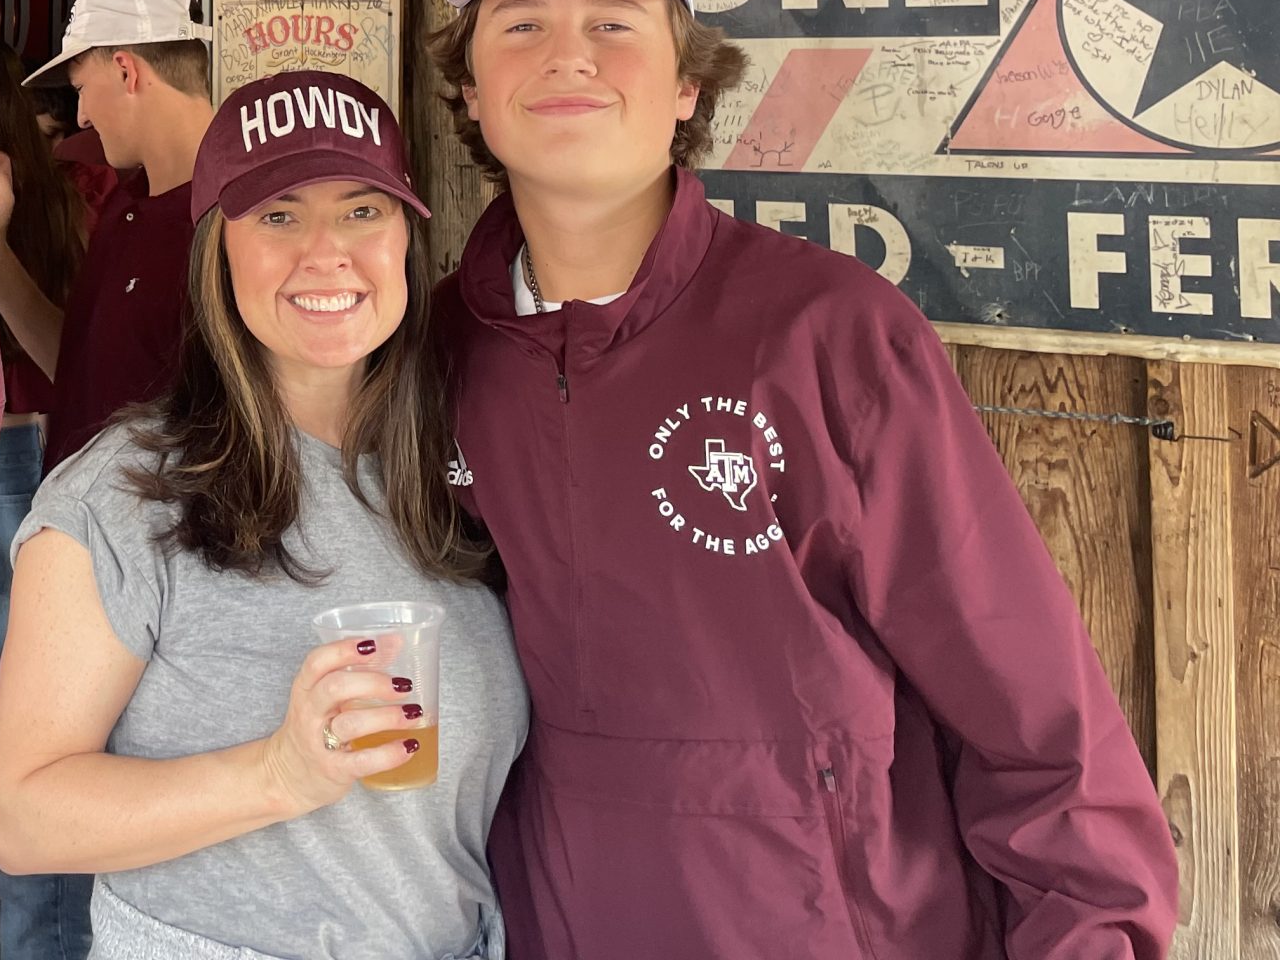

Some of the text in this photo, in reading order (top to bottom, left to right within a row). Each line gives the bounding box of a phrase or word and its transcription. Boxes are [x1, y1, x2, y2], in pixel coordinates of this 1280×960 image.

[244, 14, 360, 57] HOURS
[240, 86, 382, 152] HOWDY
[1195, 78, 1255, 102] DYLAN
[649, 396, 785, 472] ONLY THE BEST
[651, 487, 784, 555] FOR THE AGG
